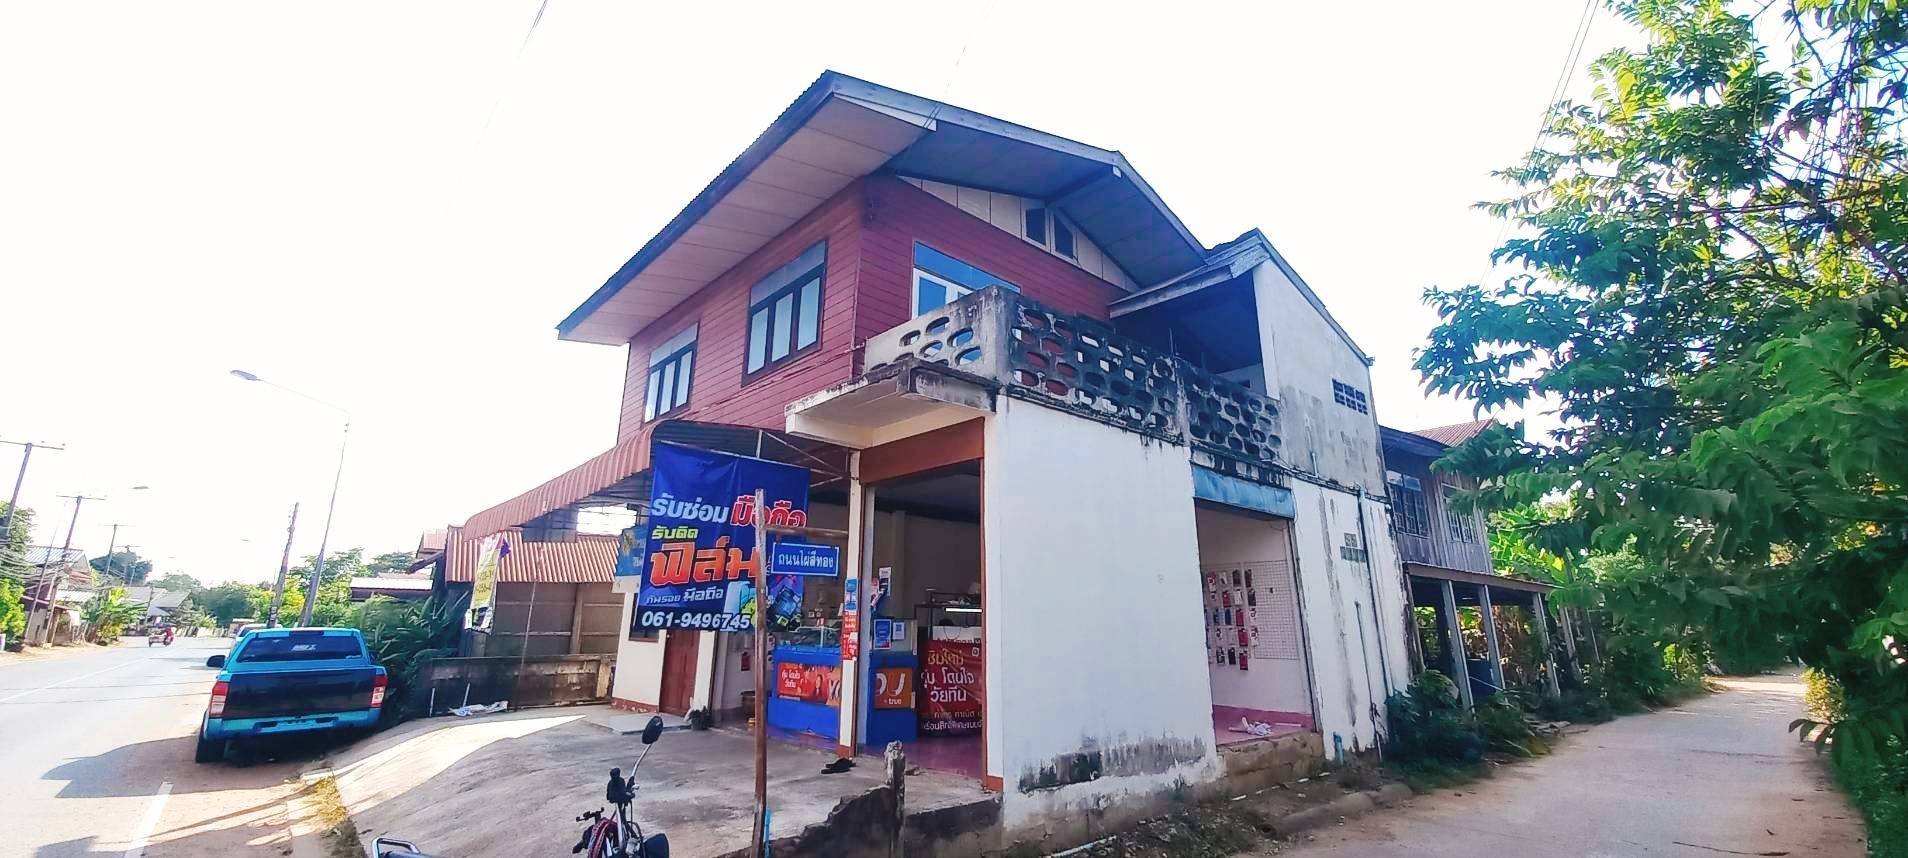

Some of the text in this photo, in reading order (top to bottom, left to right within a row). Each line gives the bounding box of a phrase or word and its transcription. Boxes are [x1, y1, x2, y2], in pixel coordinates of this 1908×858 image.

[652, 493, 729, 523] รับซ่อม
[652, 525, 698, 539] รับติด
[649, 536, 758, 587] ฟิล์ม
[778, 549, 834, 569] ถนนไผ่สีทอง
[683, 586, 725, 602] มือถือ
[640, 610, 751, 630] 061-9496745
[941, 666, 975, 684] โดนใจ
[930, 685, 967, 703] วัยทีน
